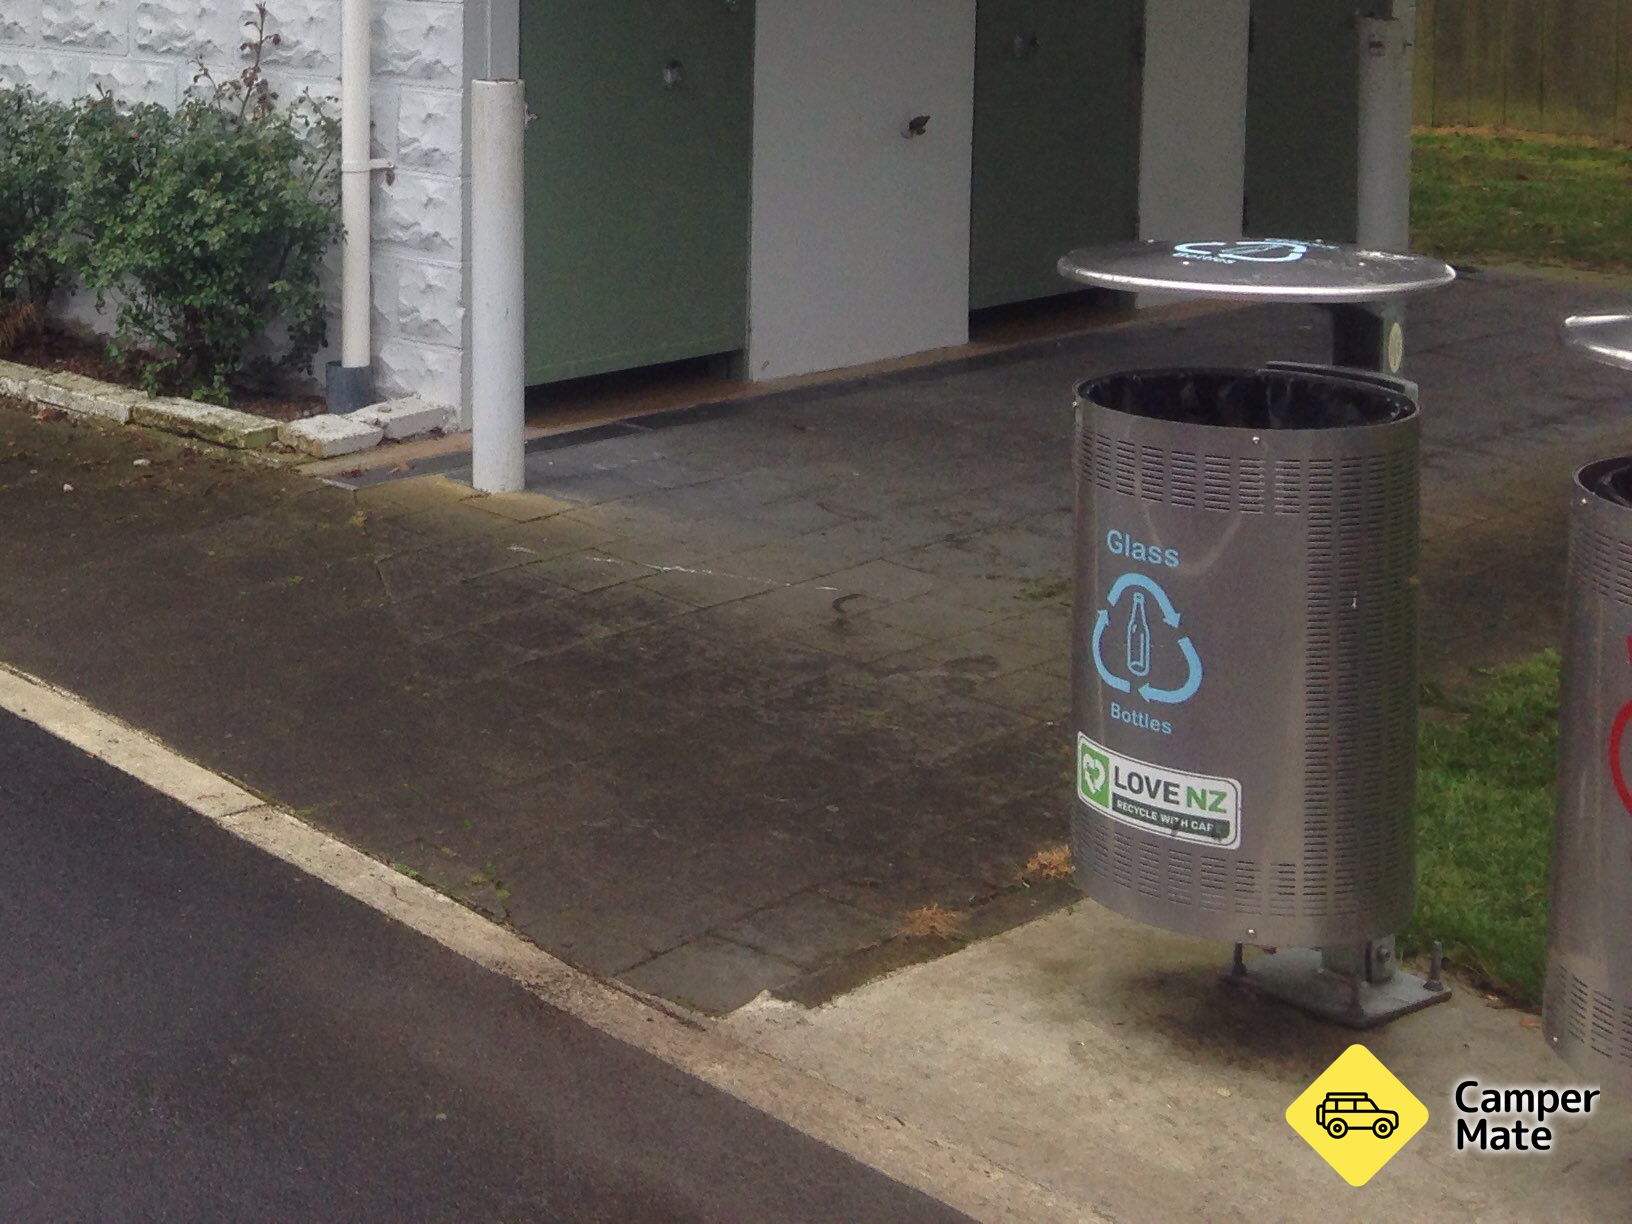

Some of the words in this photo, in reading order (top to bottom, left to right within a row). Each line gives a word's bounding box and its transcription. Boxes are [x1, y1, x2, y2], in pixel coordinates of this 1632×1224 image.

[1106, 529, 1180, 567] Glass
[1110, 702, 1173, 735] Bottles
[1114, 765, 1180, 805] LOVE
[1186, 785, 1228, 814] NZ
[1116, 799, 1159, 821] RECYCLE
[1191, 820, 1216, 832] CAR
